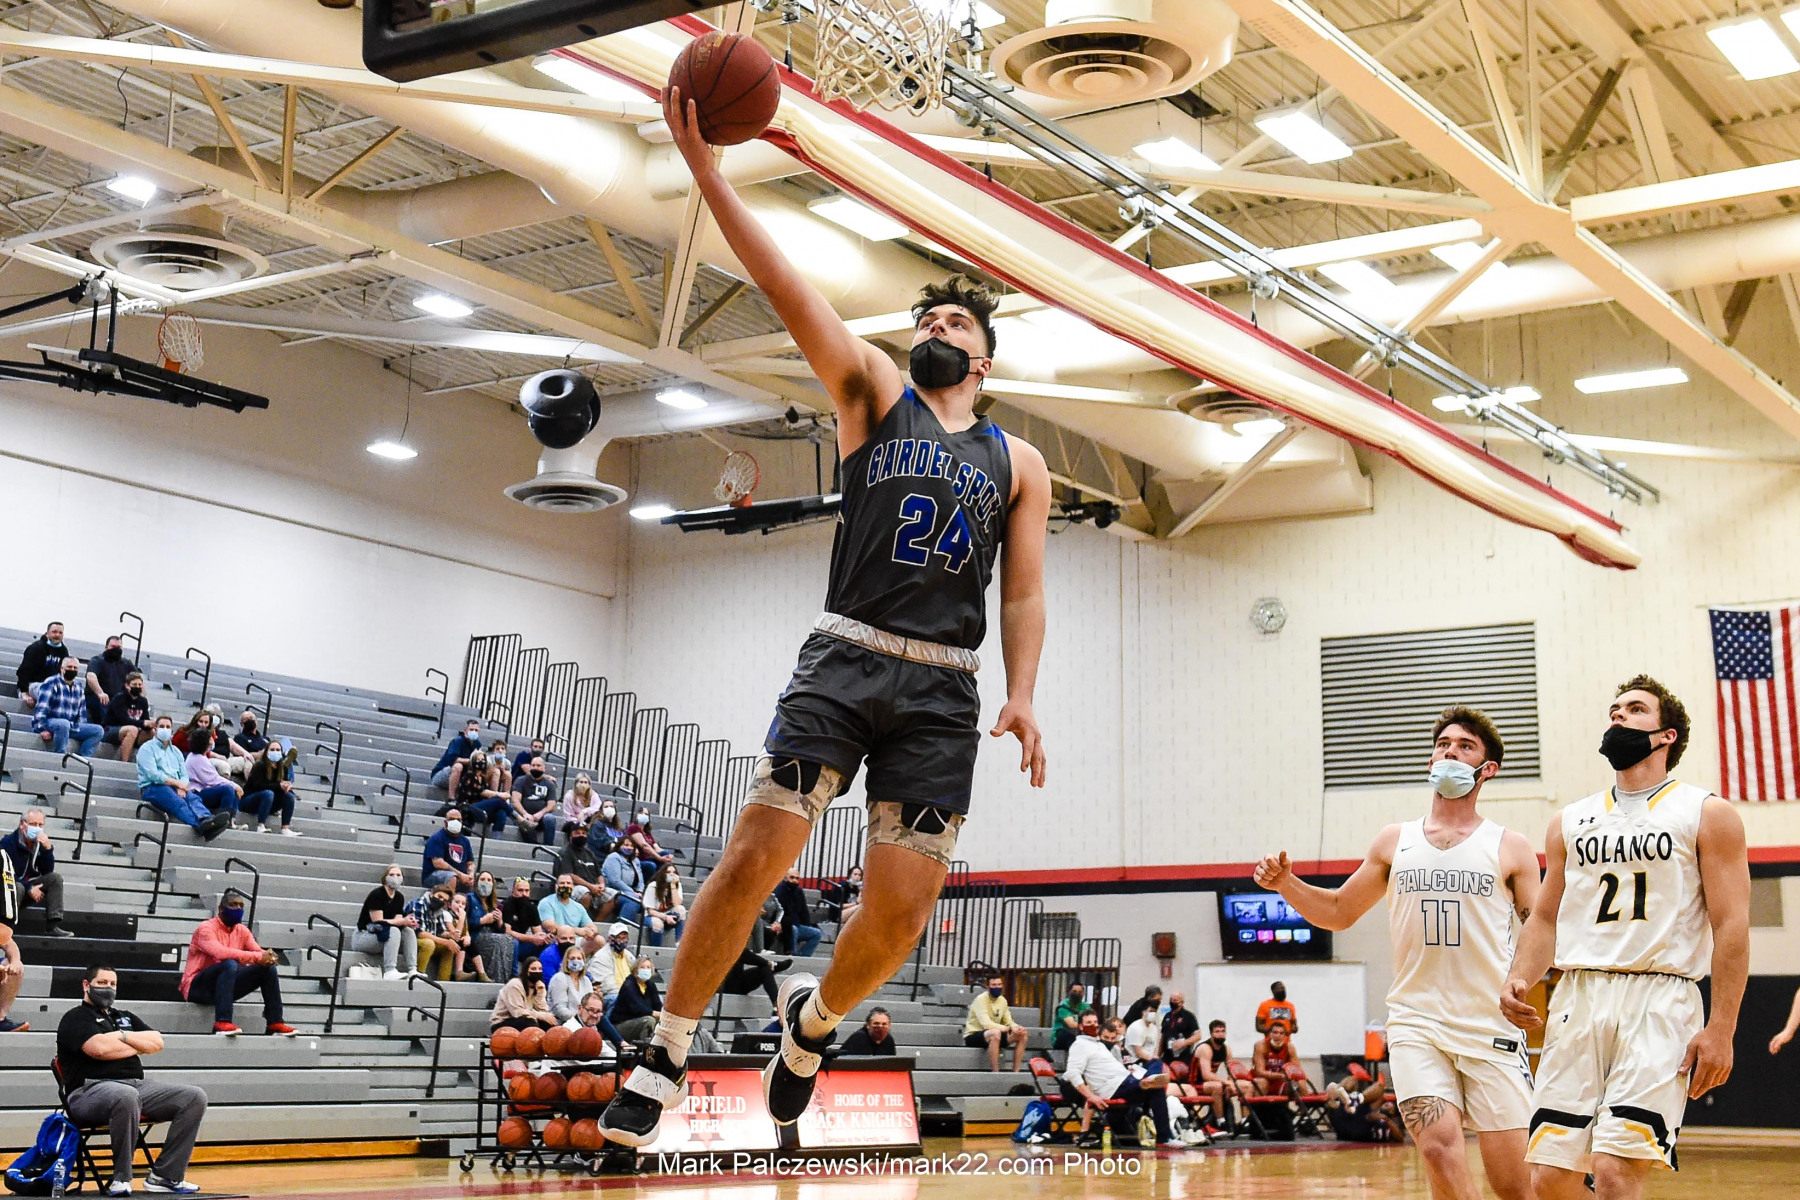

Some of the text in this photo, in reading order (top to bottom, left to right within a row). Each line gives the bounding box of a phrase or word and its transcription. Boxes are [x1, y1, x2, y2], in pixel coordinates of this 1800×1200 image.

[892, 493, 973, 574] 24
[1575, 831, 1672, 866] SOLANCO
[1396, 868, 1494, 897] FALCONS
[1595, 871, 1648, 925] 21
[1421, 899, 1461, 946] 11
[760, 1043, 775, 1052] POSS
[661, 1096, 748, 1115] MPFIELD
[834, 1093, 904, 1107] HOME OF THE
[689, 1119, 721, 1133] HIGH
[807, 1111, 914, 1129] ACK KNIGHTS
